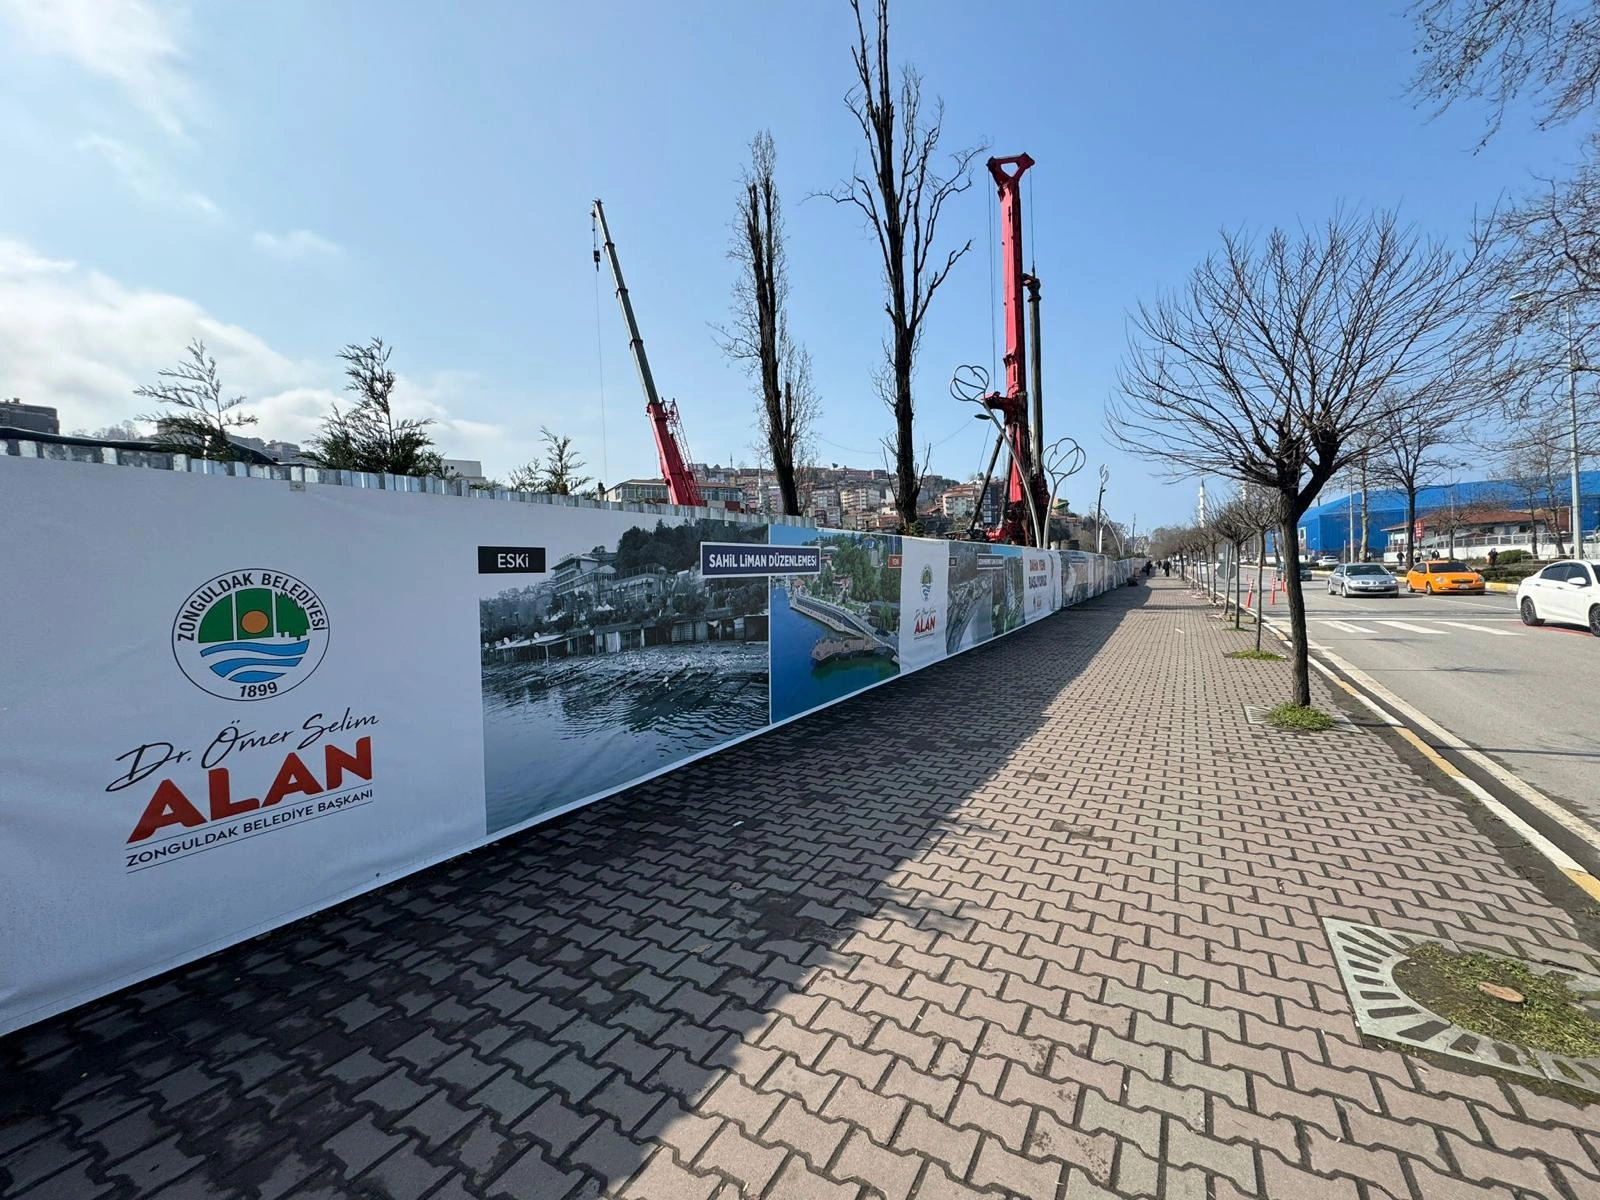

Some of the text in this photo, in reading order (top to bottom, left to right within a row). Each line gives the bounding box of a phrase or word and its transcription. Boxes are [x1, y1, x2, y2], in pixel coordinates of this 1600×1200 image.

[177, 572, 329, 642] ZONGULDAK BELEDİYESİ
[914, 615, 936, 635] ALAN
[239, 681, 278, 698] 1899
[105, 707, 379, 793] Dr. Ömer Selim
[126, 736, 373, 844] ALAN
[126, 788, 374, 868] ZONGULDAK BELEDİYE BAŞKANI
